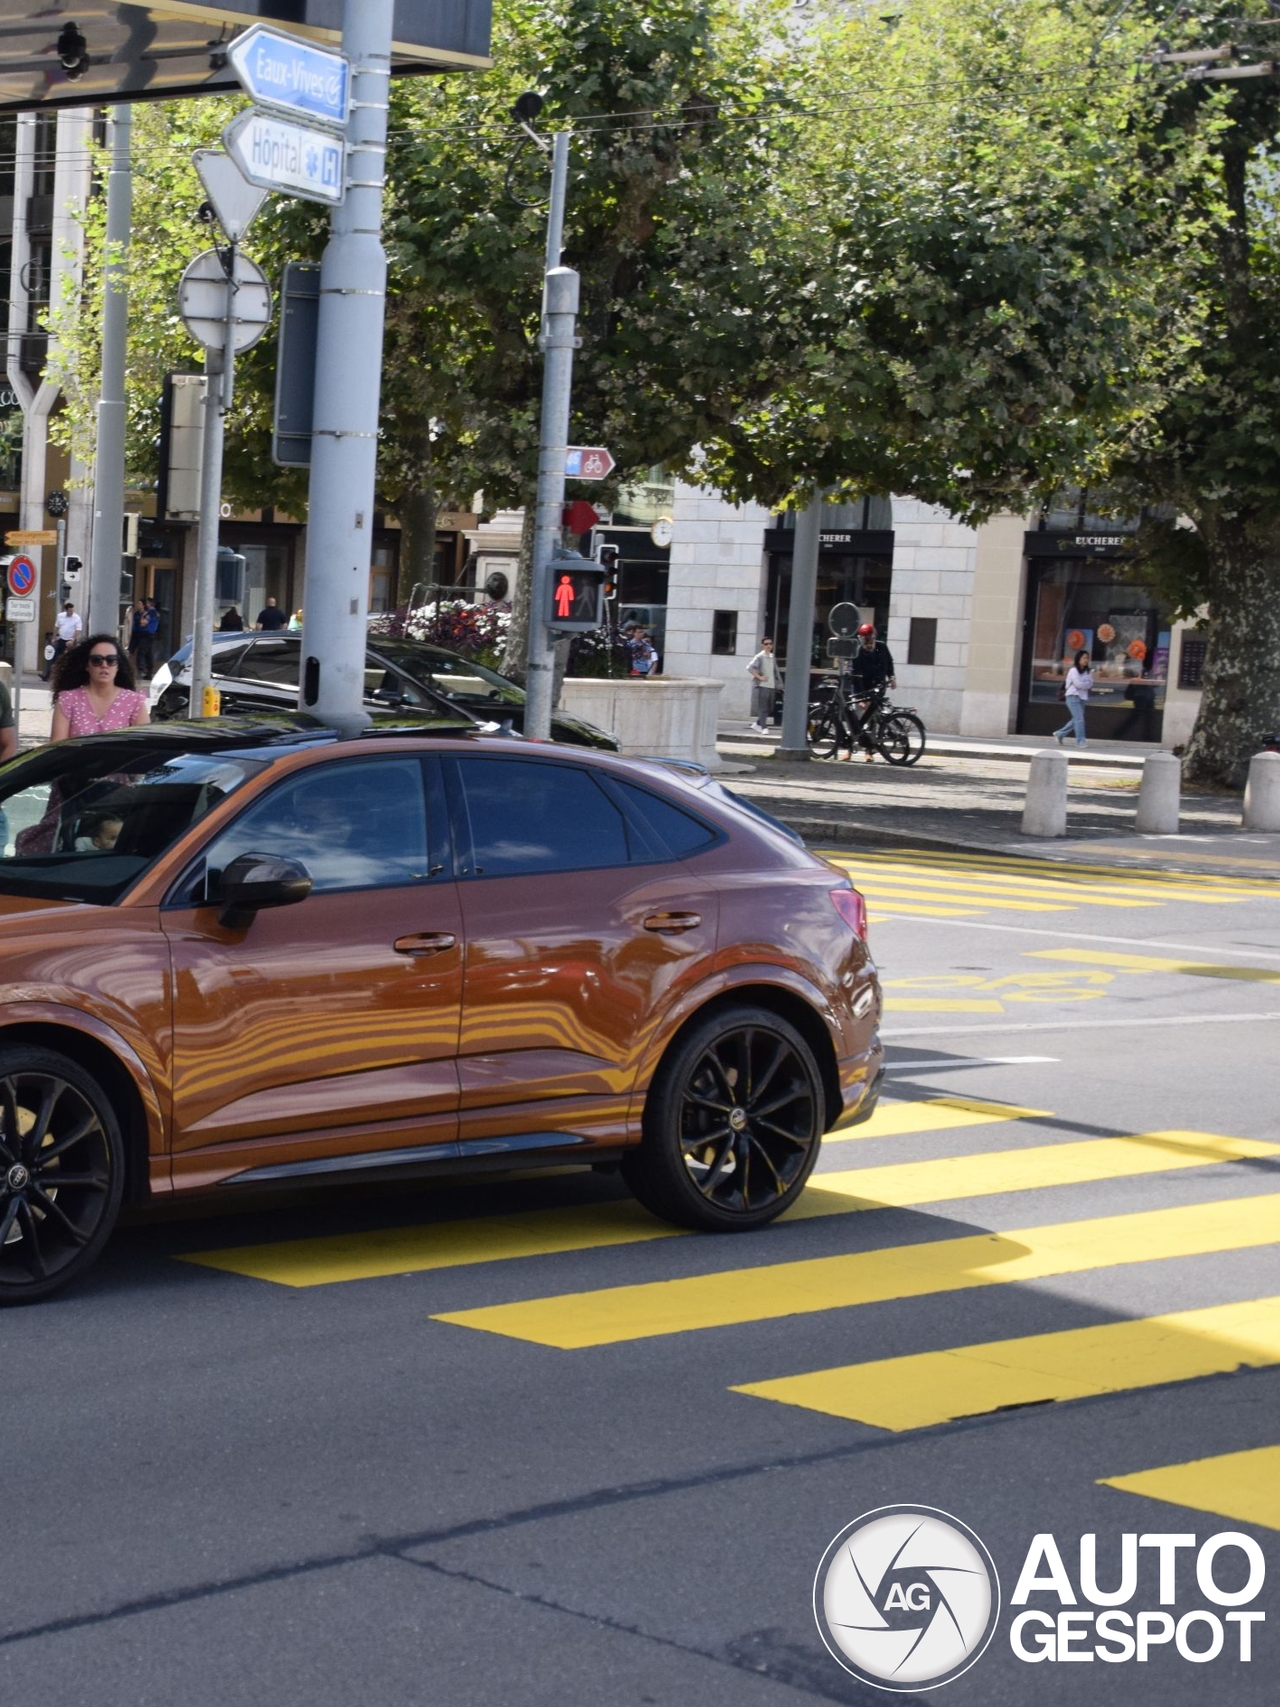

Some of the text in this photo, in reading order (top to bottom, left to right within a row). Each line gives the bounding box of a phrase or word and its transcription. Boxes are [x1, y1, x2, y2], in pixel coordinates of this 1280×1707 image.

[256, 47, 324, 99] Eaux-Vives
[252, 125, 302, 179] Hôpital
[819, 534, 851, 543] CHERER
